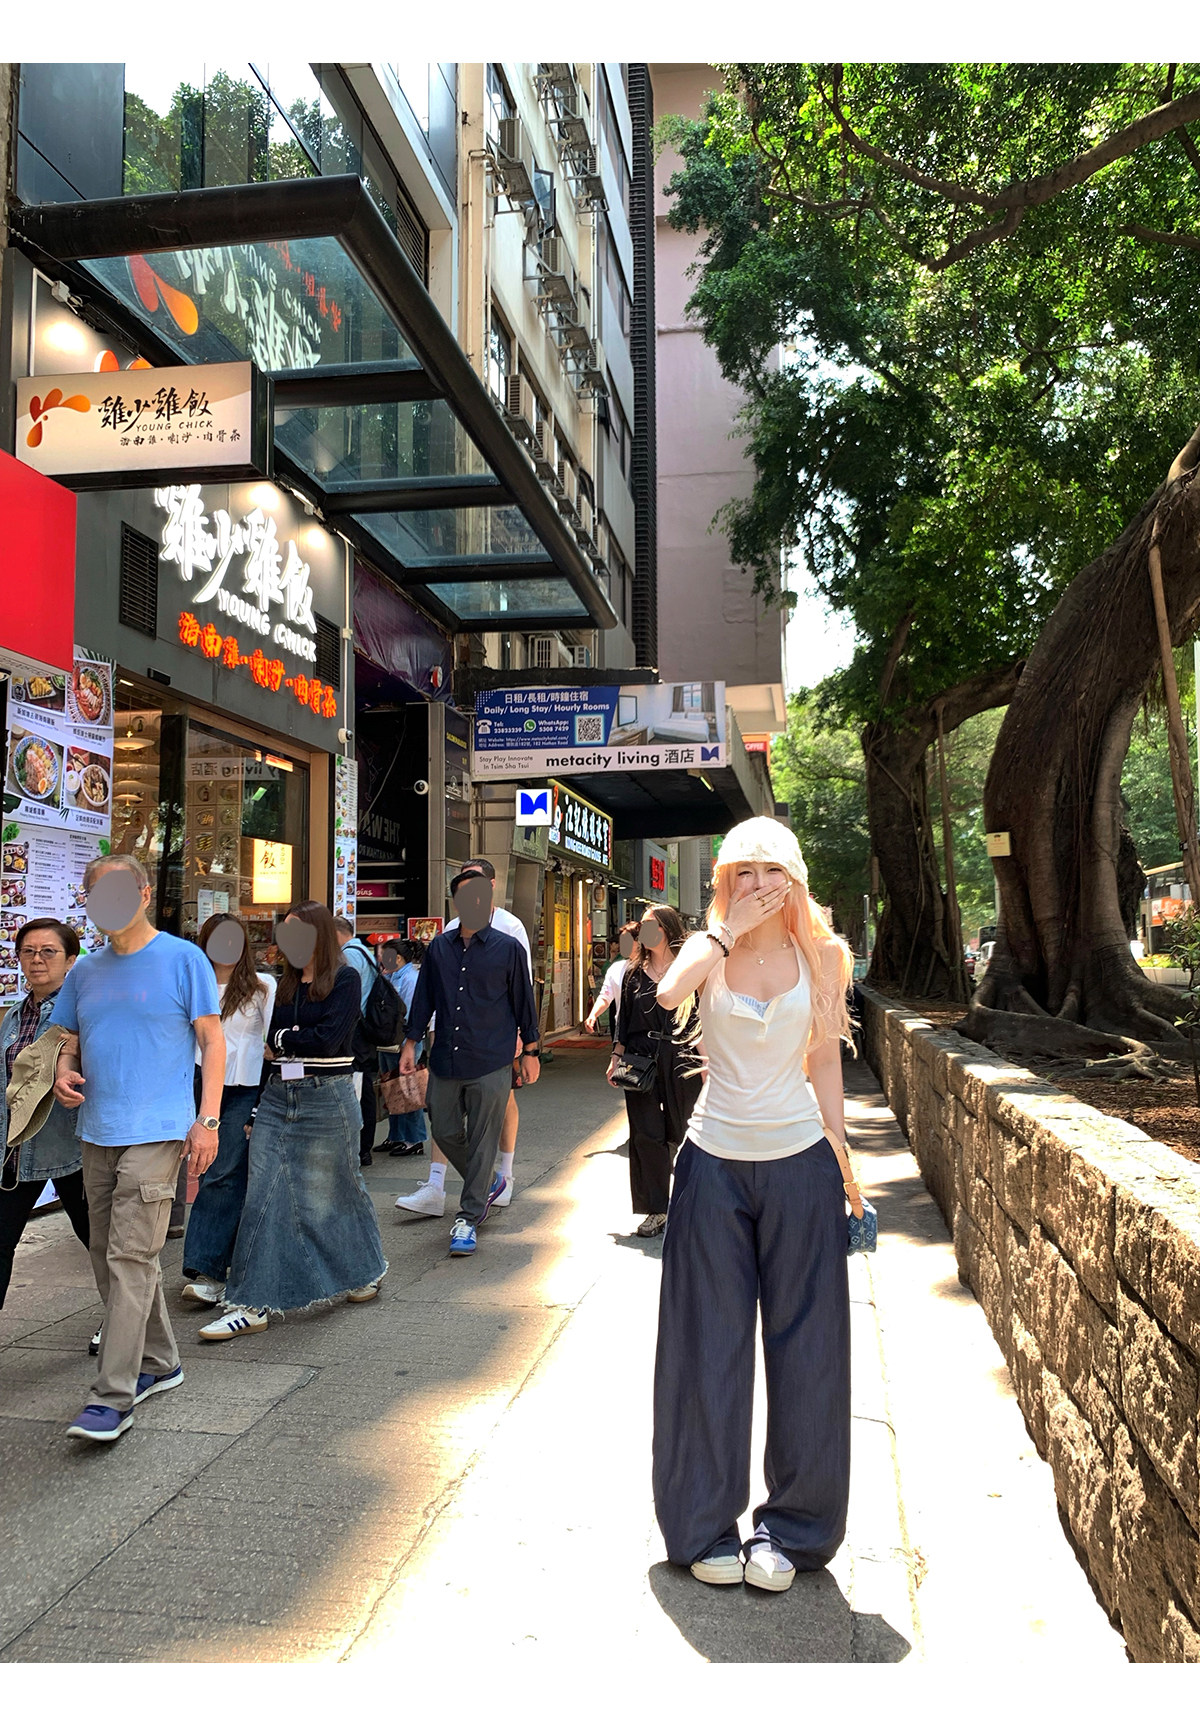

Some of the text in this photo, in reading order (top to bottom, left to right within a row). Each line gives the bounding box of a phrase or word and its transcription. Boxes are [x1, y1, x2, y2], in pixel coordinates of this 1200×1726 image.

[136, 420, 213, 432] YOUNG CHICK
[217, 588, 317, 663] YOUNG CHICK
[505, 691, 589, 704] 日租/長租/時鐘住宿
[484, 703, 610, 715] Daily/ Long Stay/ Hourly Rooms
[744, 742, 764, 751] OFFEE
[493, 755, 506, 763] Play
[546, 749, 694, 768] metacity living 酒店
